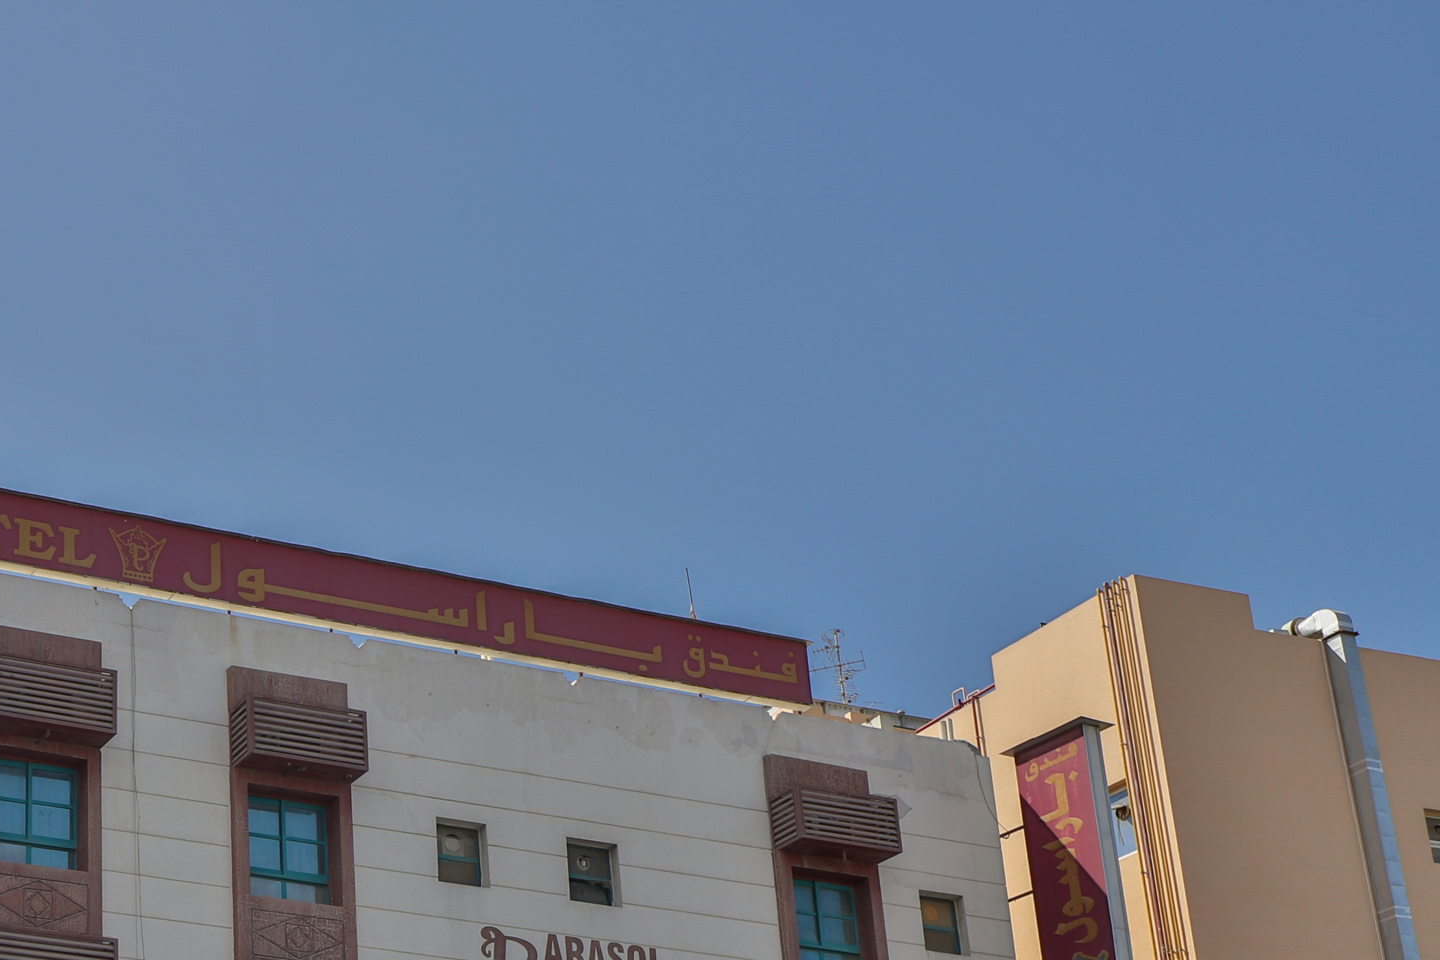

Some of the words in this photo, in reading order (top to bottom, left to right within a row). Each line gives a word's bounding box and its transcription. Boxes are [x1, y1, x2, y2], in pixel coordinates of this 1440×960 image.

[182, 541, 663, 671] باراسول
[683, 634, 798, 679] فندق
[1025, 742, 1078, 782] فندق
